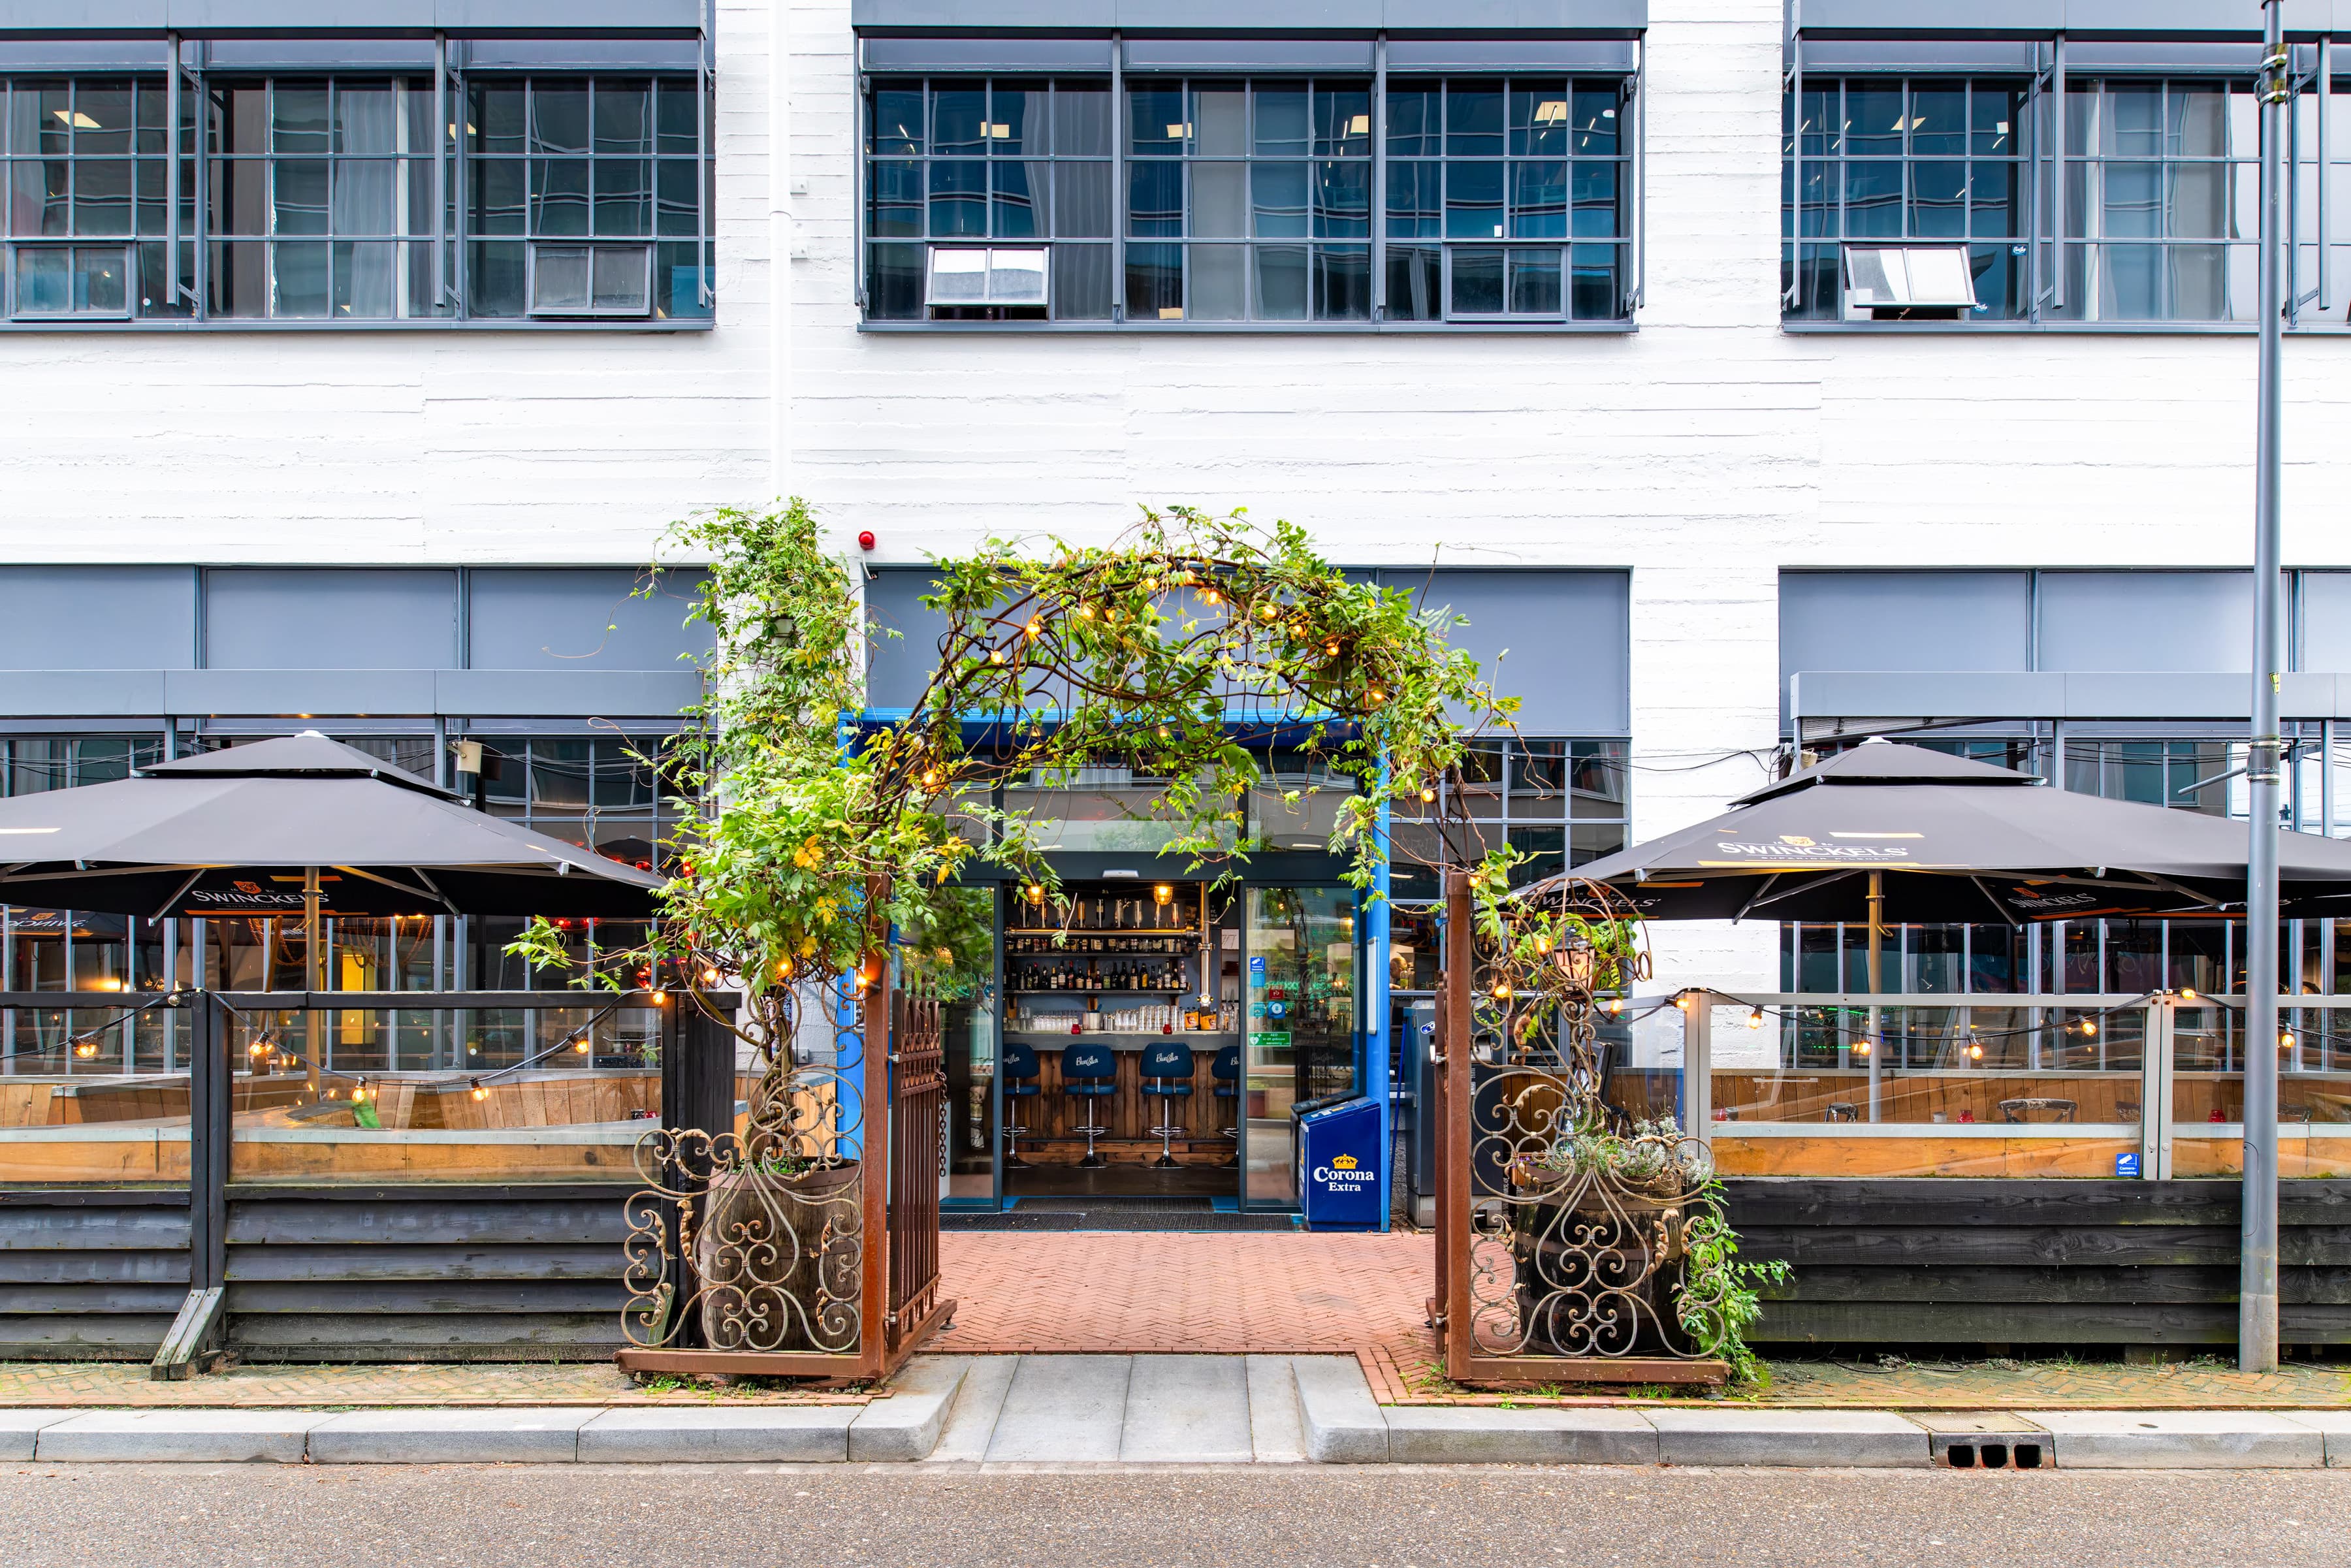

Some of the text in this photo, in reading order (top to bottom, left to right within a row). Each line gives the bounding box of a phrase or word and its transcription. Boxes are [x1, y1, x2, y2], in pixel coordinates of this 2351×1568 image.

[1718, 842, 1908, 856] SWINCKELS'
[1313, 1166, 1375, 1182] Corona
[1328, 1182, 1361, 1191] Extra
